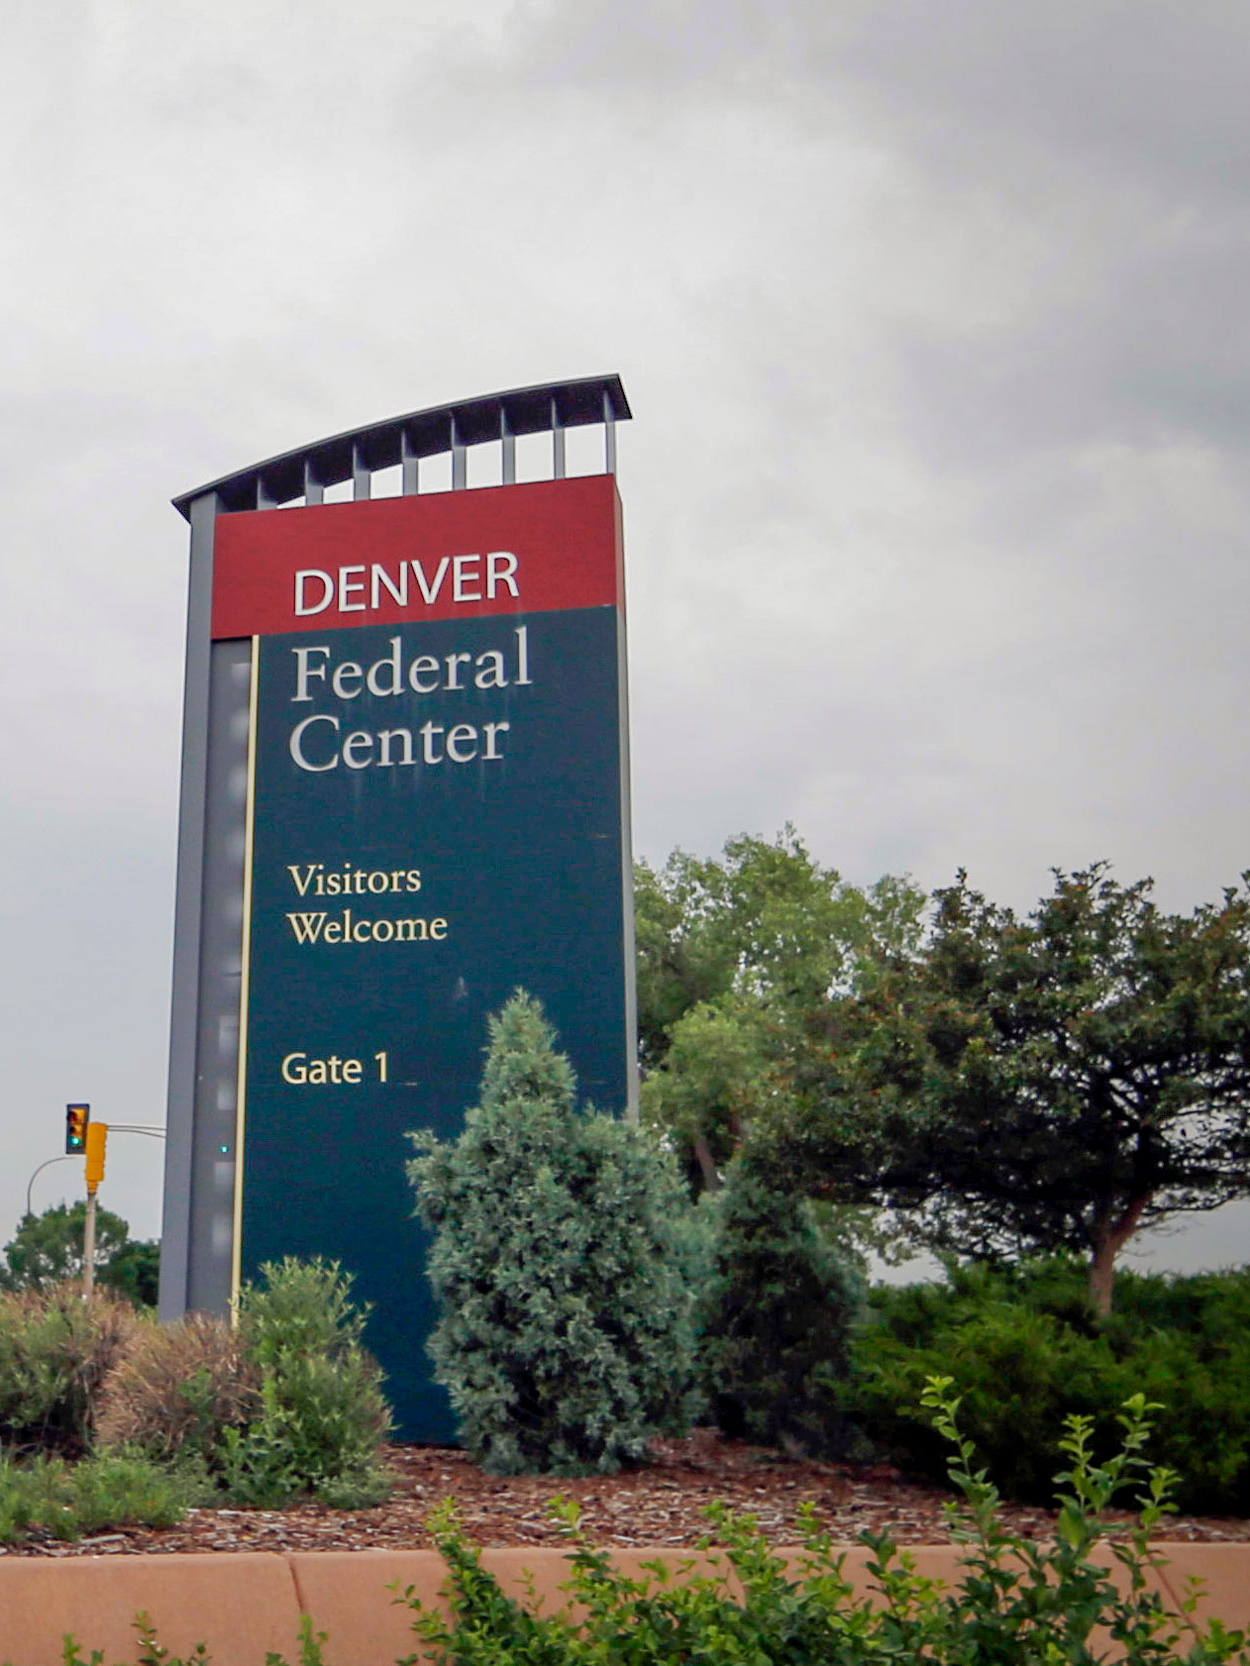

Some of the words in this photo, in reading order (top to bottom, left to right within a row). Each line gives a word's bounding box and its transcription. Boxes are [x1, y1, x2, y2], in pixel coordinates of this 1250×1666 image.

[293, 551, 520, 617] DENVER
[290, 625, 533, 702] Federal
[289, 714, 510, 772] Center
[287, 863, 422, 896] Visitors
[286, 909, 448, 944] Welcome
[281, 1052, 362, 1085] Gate
[374, 1051, 388, 1083] 1
